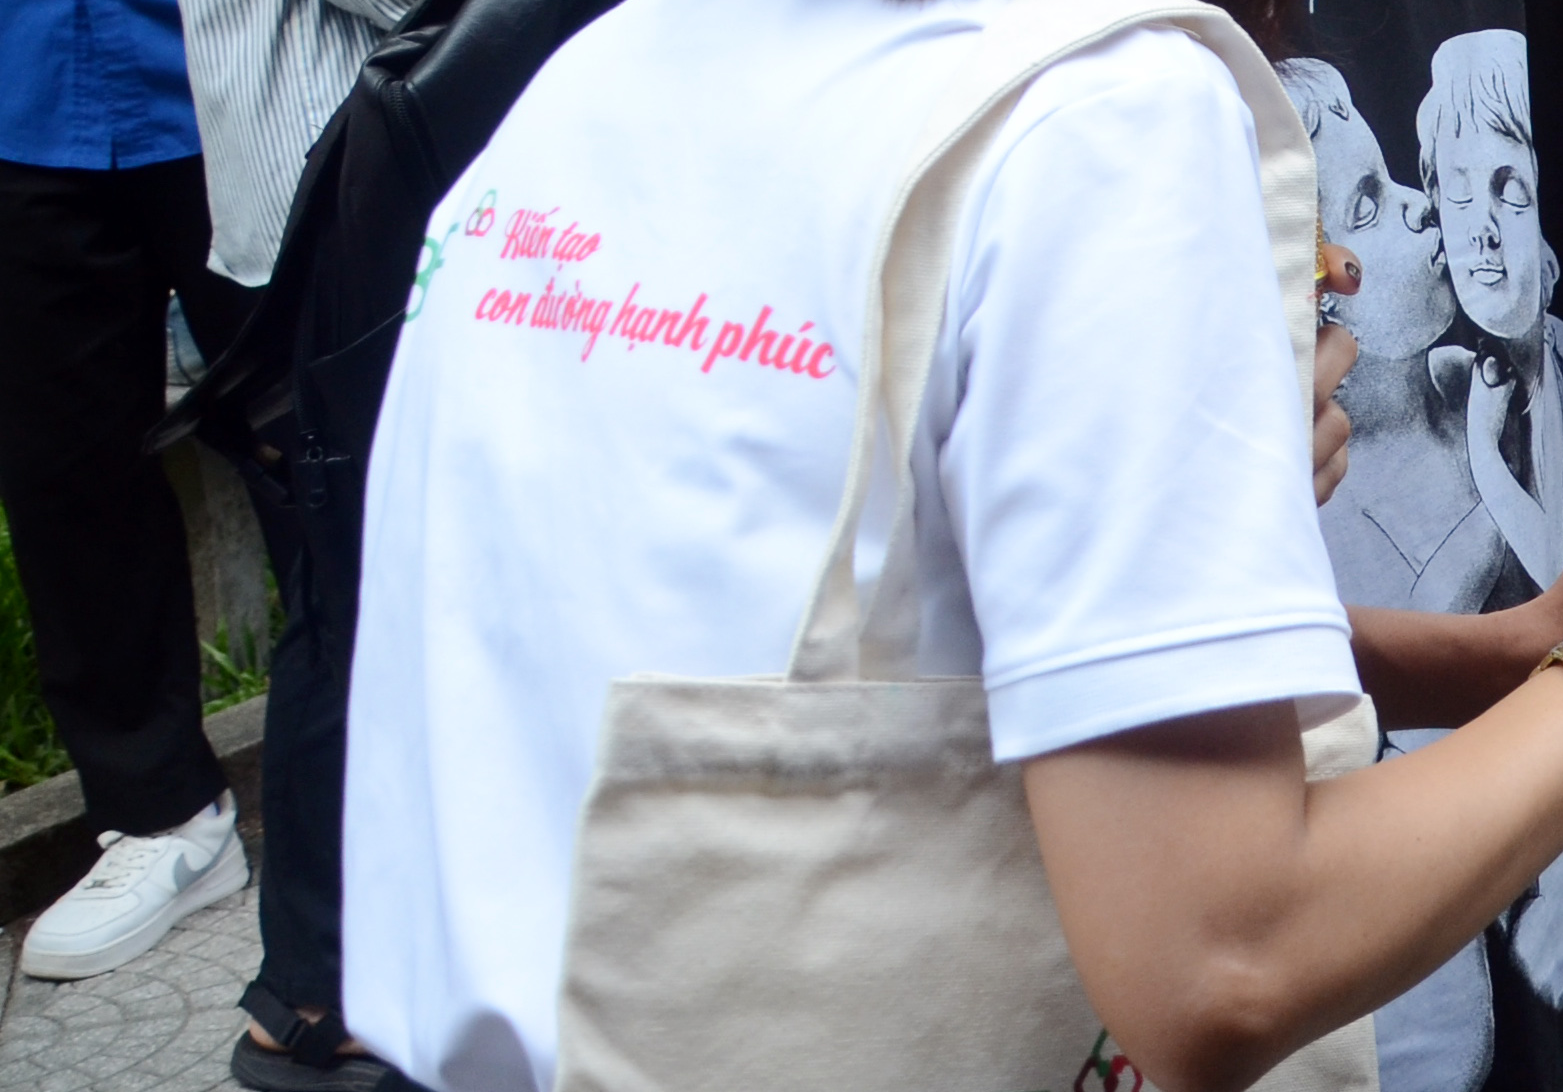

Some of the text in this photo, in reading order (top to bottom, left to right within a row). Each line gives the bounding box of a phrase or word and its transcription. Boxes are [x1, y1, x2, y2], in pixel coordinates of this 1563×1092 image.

[500, 206, 603, 271] Kiến tạo
[474, 275, 837, 379] con đường hạnh phúc
